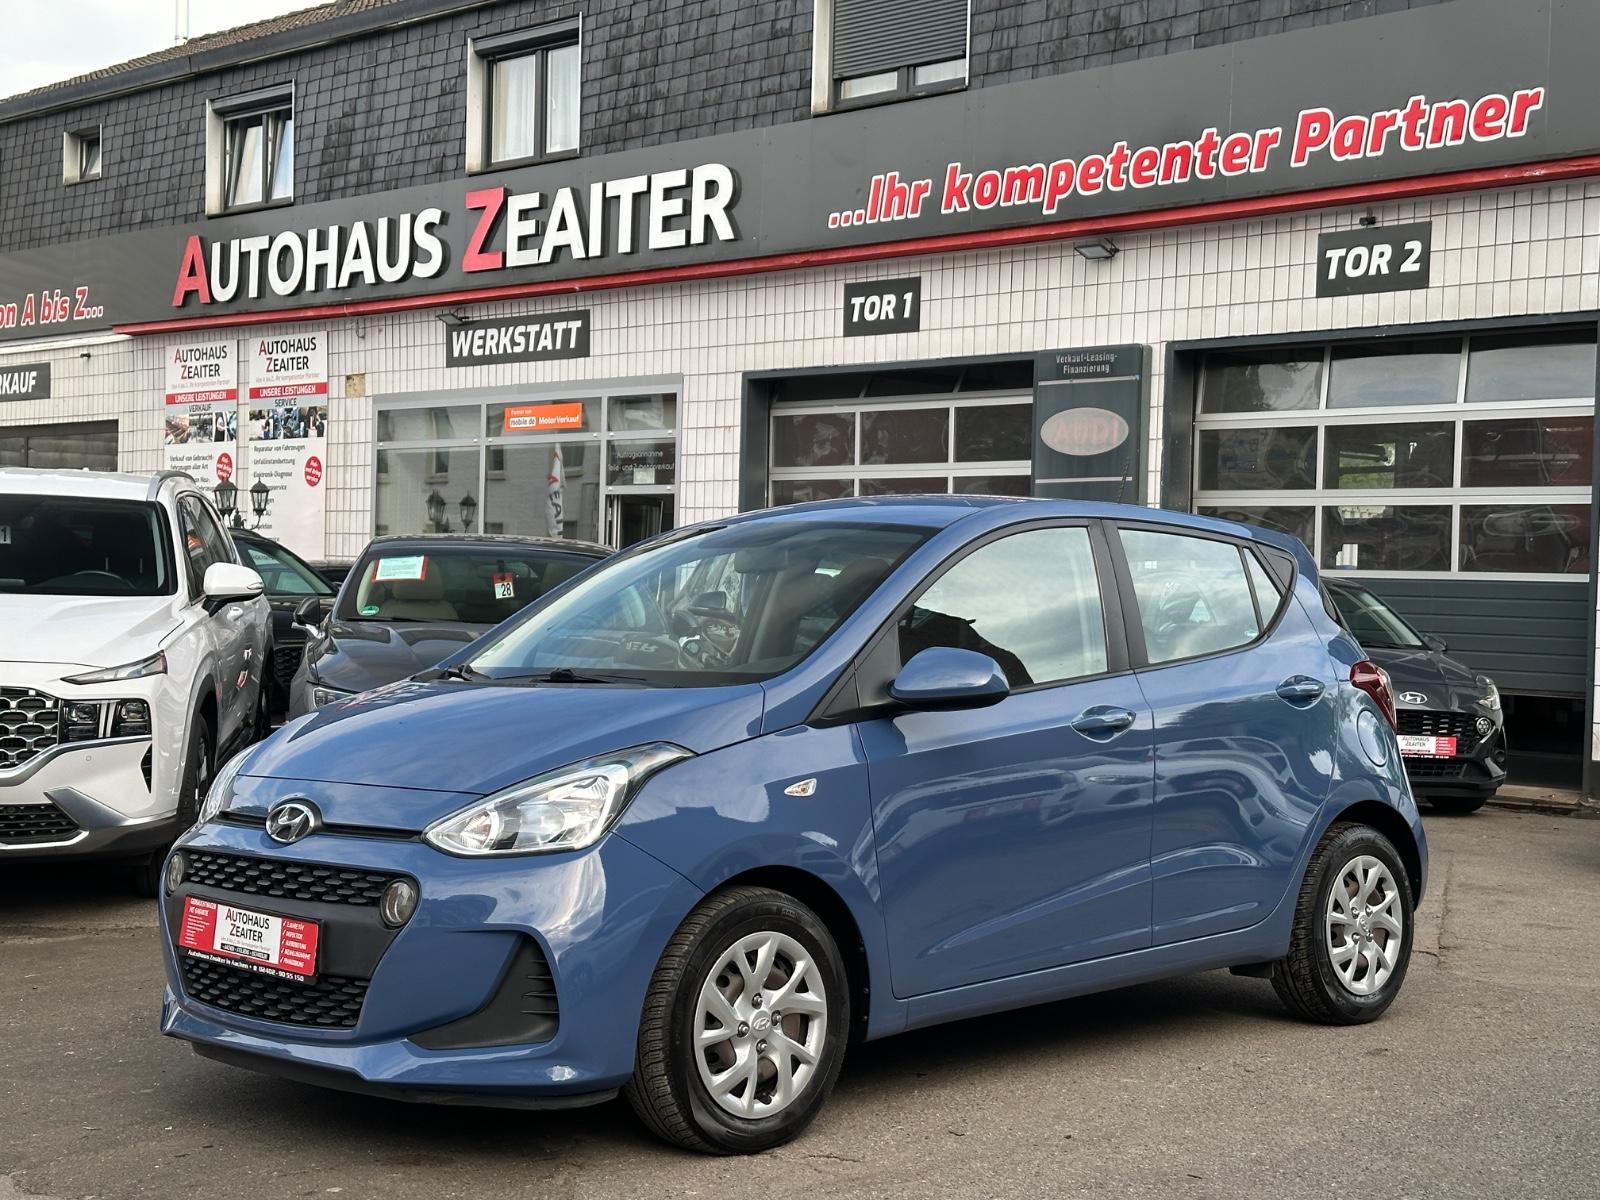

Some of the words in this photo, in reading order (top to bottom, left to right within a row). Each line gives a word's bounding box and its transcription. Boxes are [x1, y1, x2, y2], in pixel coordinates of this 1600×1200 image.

[941, 127, 1281, 215] kompetenter
[1290, 87, 1545, 168] Partner
[172, 208, 444, 308] AUTOHAUS
[462, 163, 735, 273] ZEAITER
[1325, 243, 1392, 280] TOR
[1399, 240, 1422, 273] 2
[21, 293, 35, 327] A
[40, 289, 70, 324] bis
[850, 293, 896, 323] TOR
[902, 292, 913, 318] 1
[258, 337, 317, 356] AUTOHAUS
[452, 320, 582, 358] WERKSTATT
[174, 345, 228, 364] AUTOHAUS
[181, 364, 221, 380] ZEAITER
[266, 356, 310, 373] ZEAITER
[1063, 363, 1110, 374] Finanzierung
[0, 371, 37, 395] KAUF
[259, 387, 281, 397] UNSERE
[282, 385, 316, 395] LEISTUNGEN
[189, 404, 212, 412] VERKAUF
[275, 398, 297, 407] SERVICE
[501, 583, 512, 596] 28
[225, 908, 270, 930] AUTOHAUS
[229, 923, 263, 943] ZEAITER
